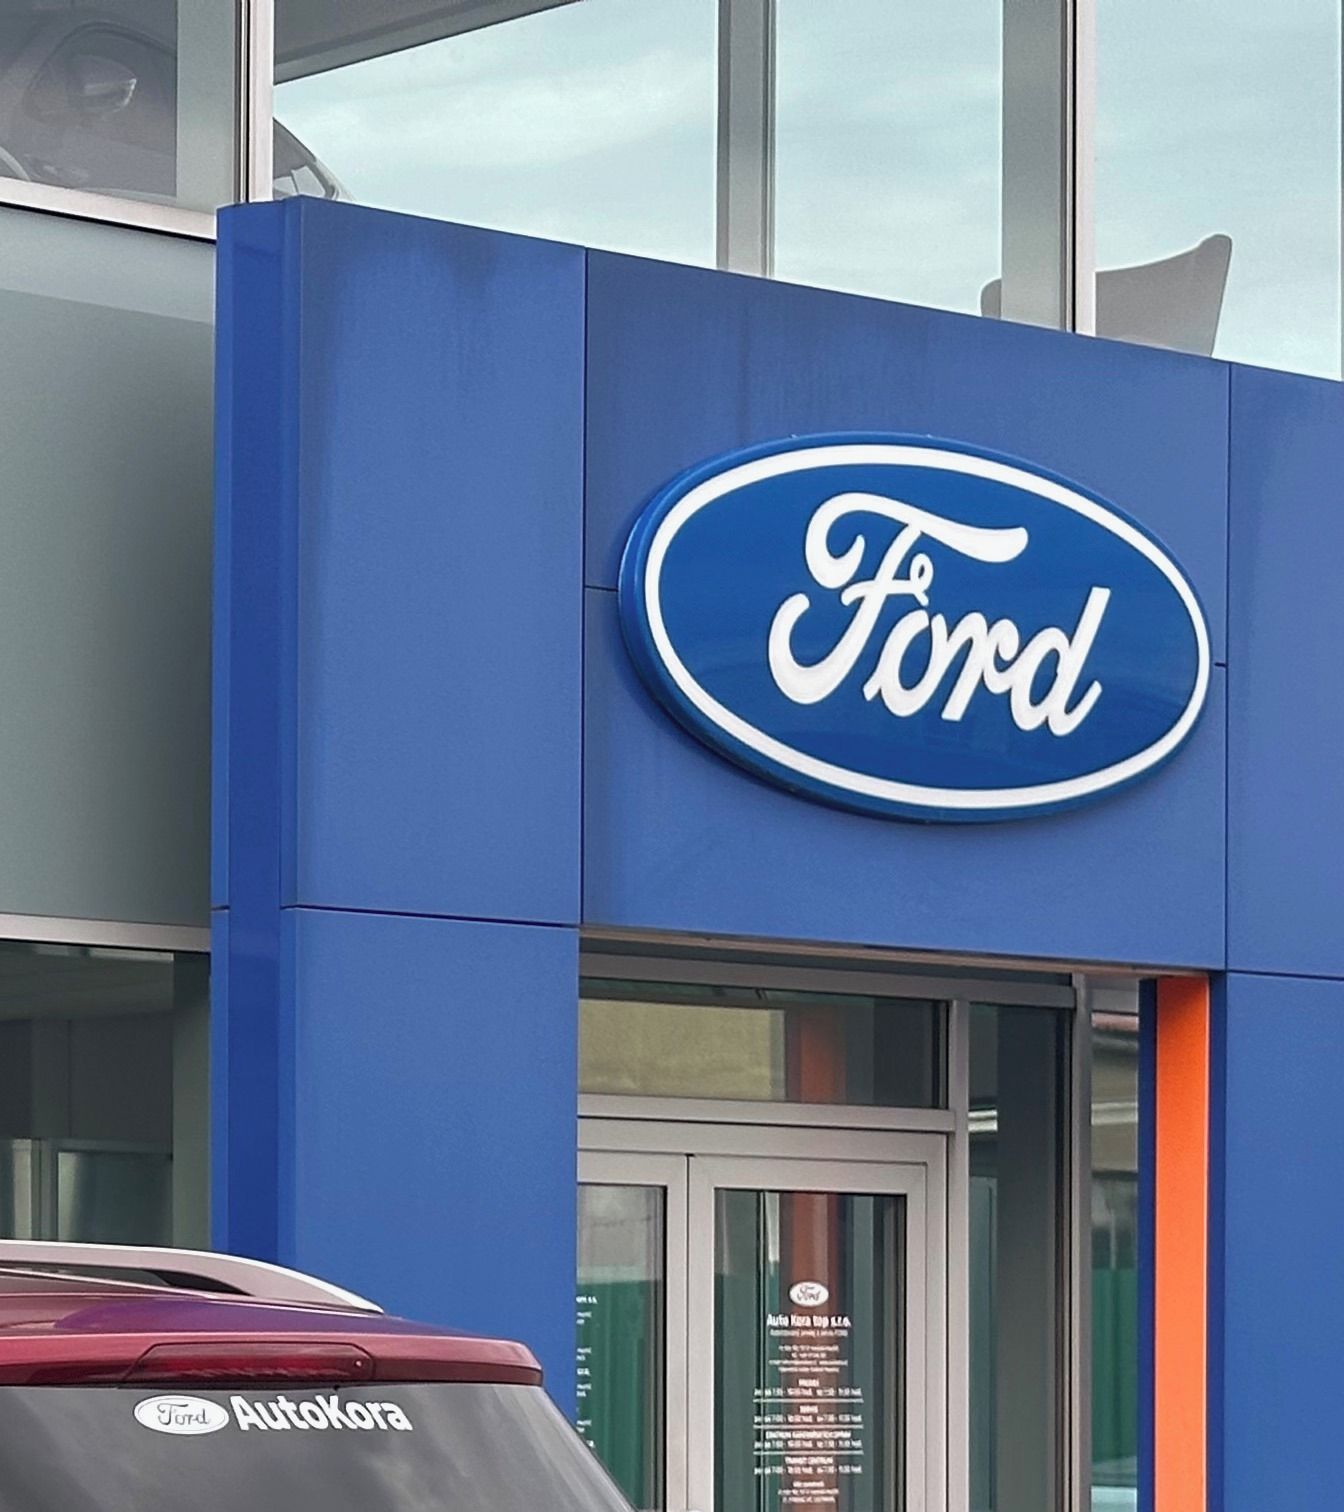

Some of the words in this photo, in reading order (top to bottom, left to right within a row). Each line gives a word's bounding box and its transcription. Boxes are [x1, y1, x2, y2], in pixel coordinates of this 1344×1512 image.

[768, 492, 1110, 736] Ford
[766, 1313, 789, 1327] Auto
[157, 1403, 210, 1426] Ford
[230, 1395, 413, 1431] AutoKora
